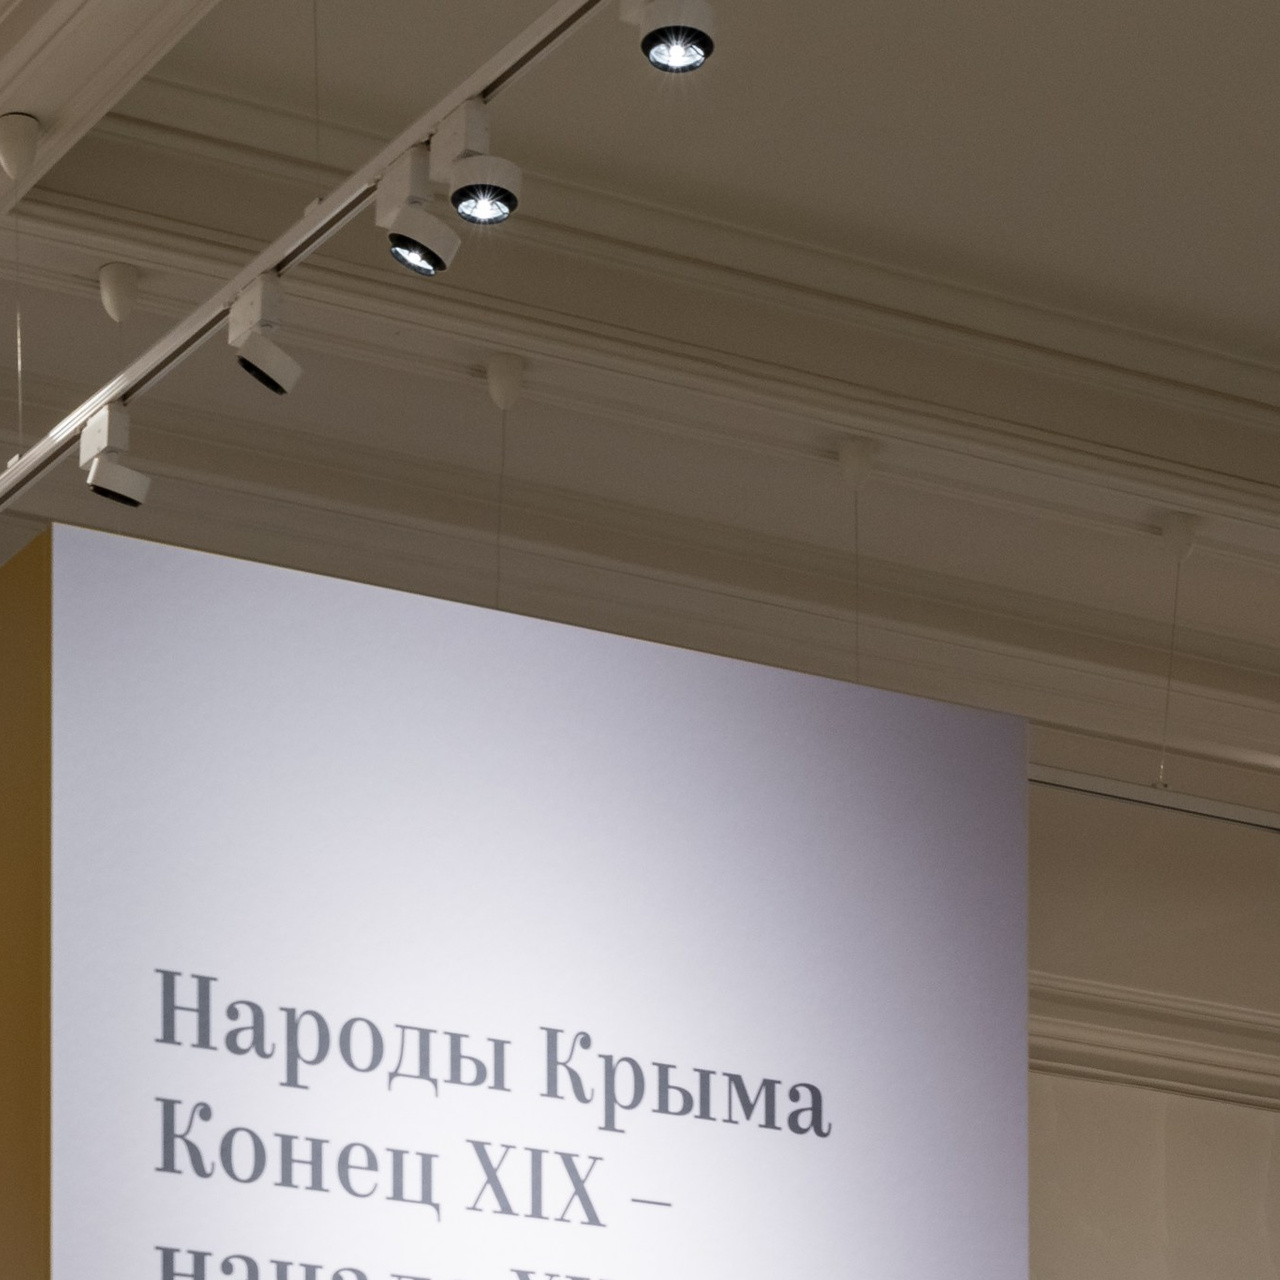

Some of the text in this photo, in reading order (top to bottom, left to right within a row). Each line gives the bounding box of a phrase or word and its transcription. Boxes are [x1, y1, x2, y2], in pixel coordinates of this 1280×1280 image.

[154, 968, 832, 1138] Народы Крыма
[154, 1097, 441, 1221] Конец
[465, 1139, 607, 1227] XIX
